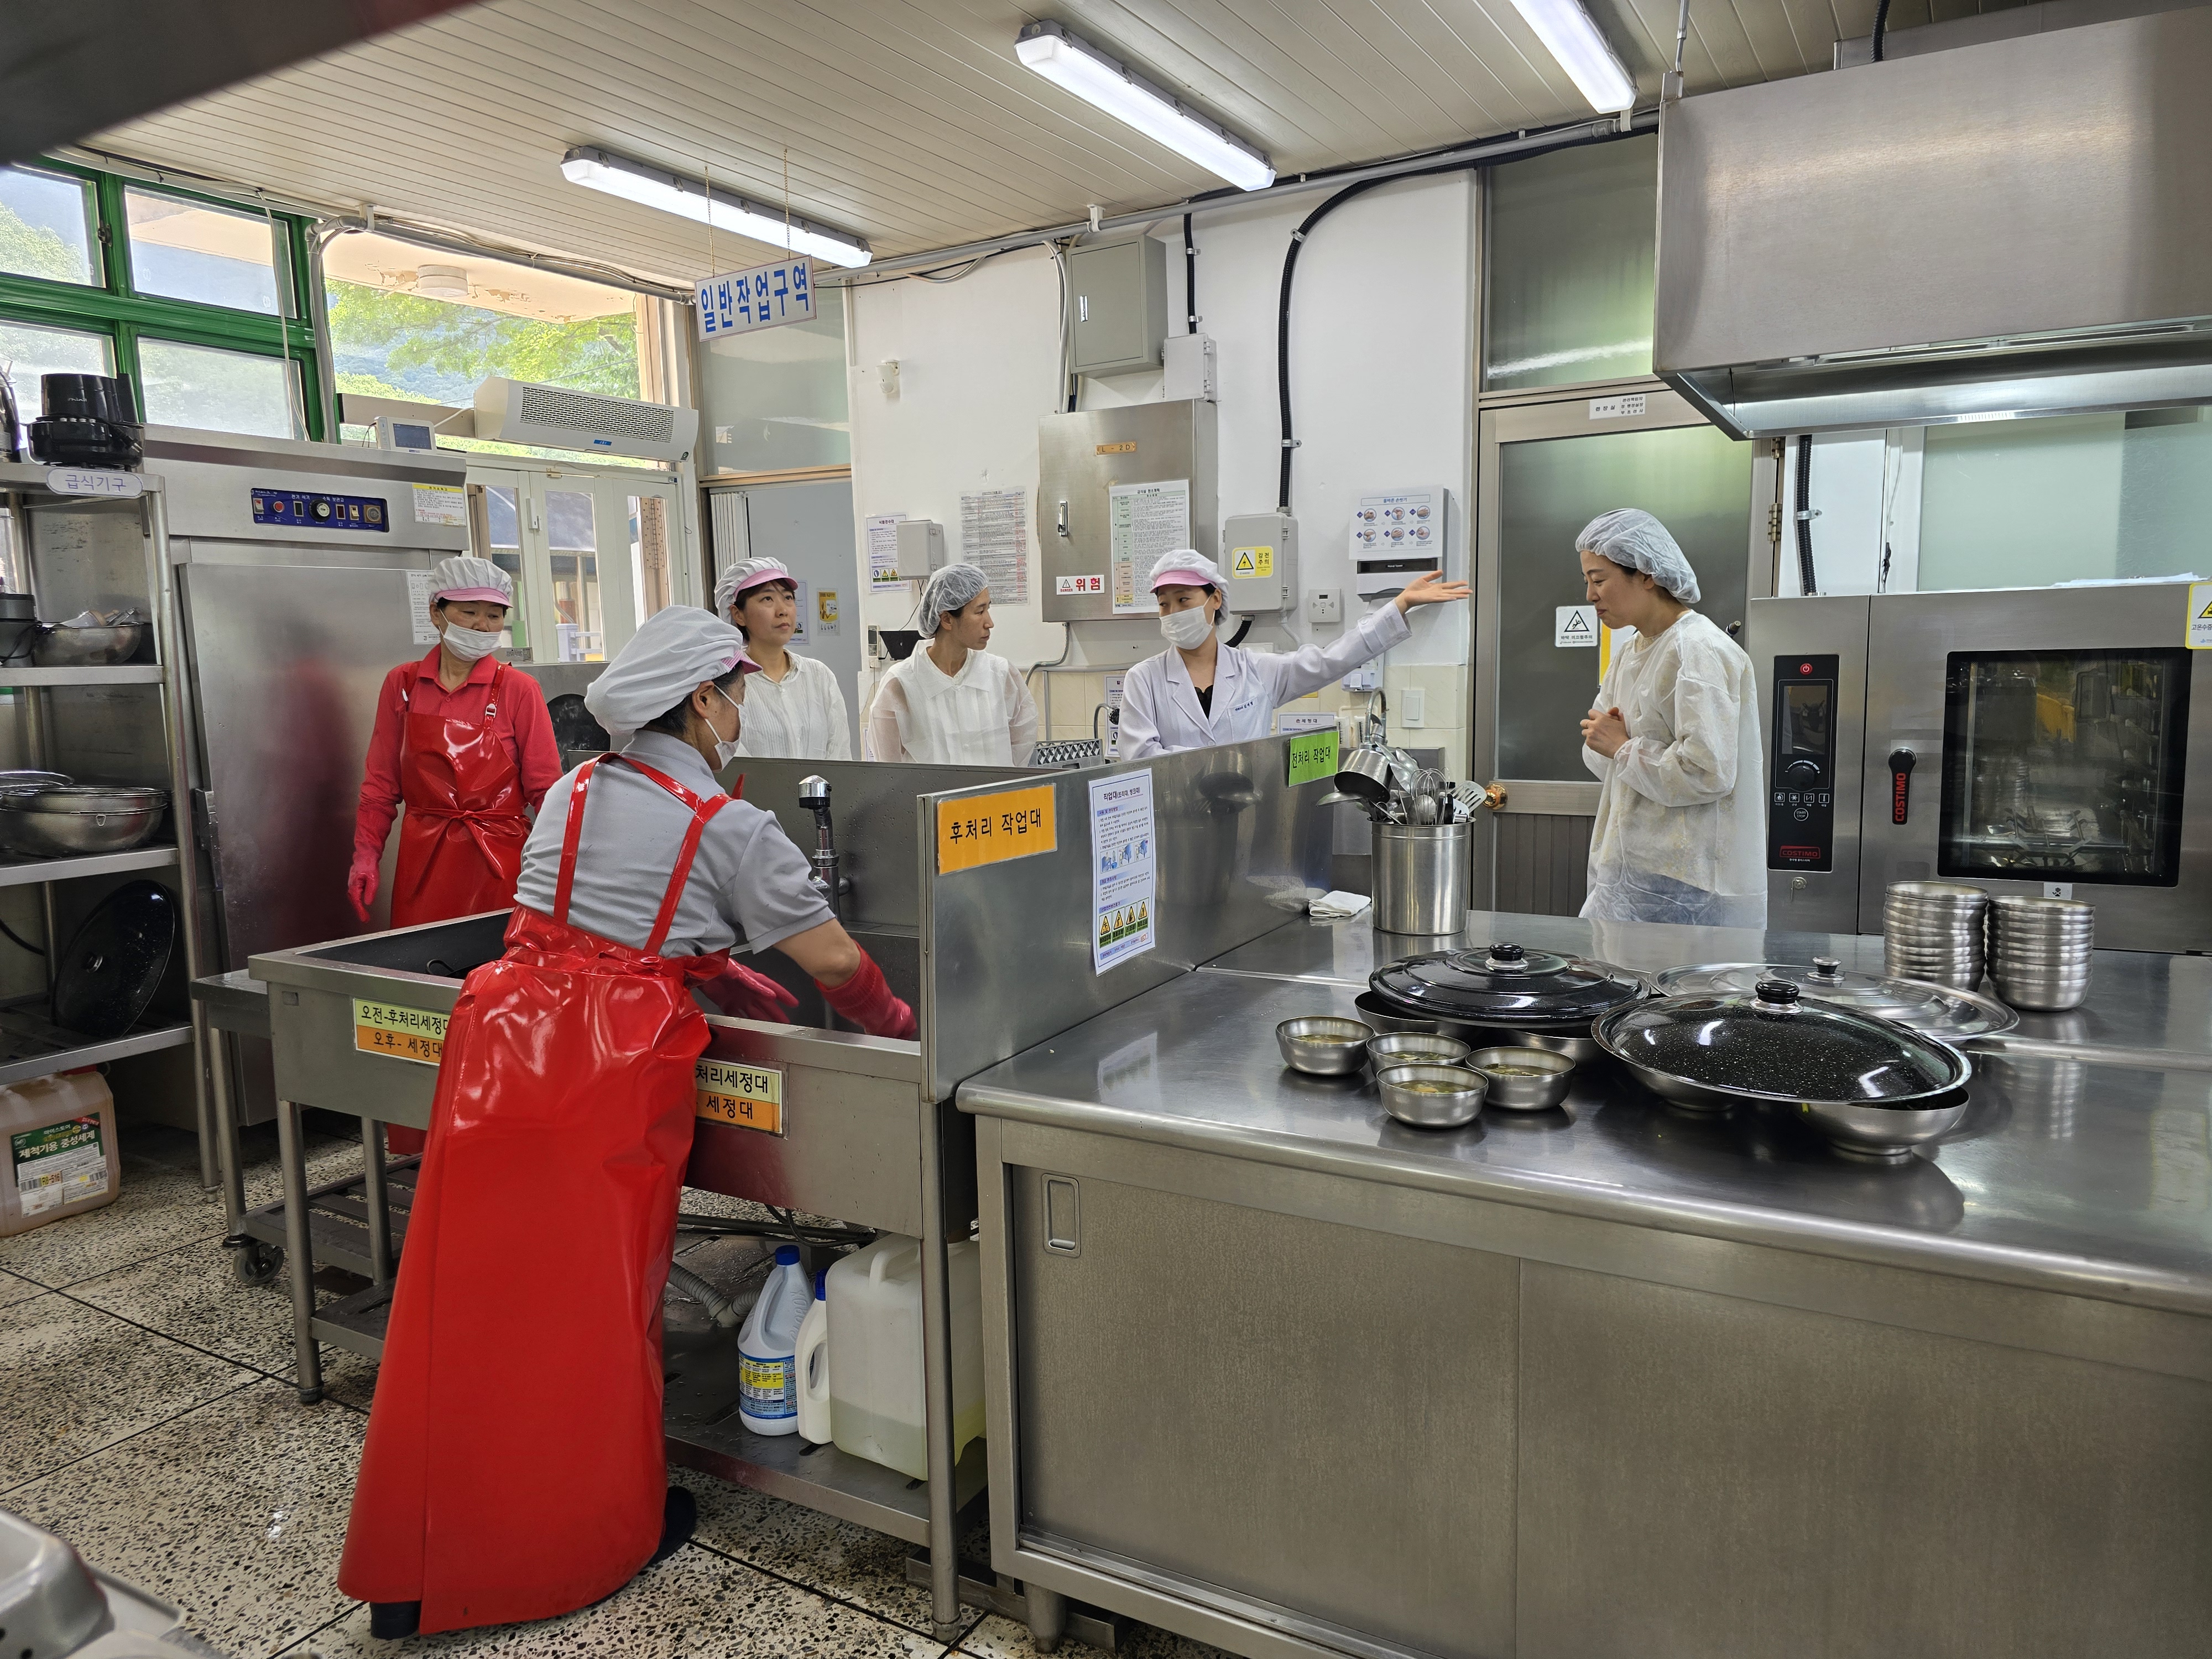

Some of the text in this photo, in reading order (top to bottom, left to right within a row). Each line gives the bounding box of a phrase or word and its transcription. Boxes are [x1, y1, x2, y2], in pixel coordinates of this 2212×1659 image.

[701, 262, 809, 333] 일반작업구역
[65, 474, 127, 492] 급식기구
[1076, 577, 1100, 591] 위험
[1292, 746, 1331, 769] 전처리 작업대
[1895, 773, 1906, 822] COSTIMO
[950, 808, 1041, 844] 후처리 작업대
[408, 1038, 442, 1058] 세정대
[696, 1065, 768, 1093] 처리세정대
[706, 1095, 753, 1120] 세정대
[60, 1130, 95, 1148] 중성세제
